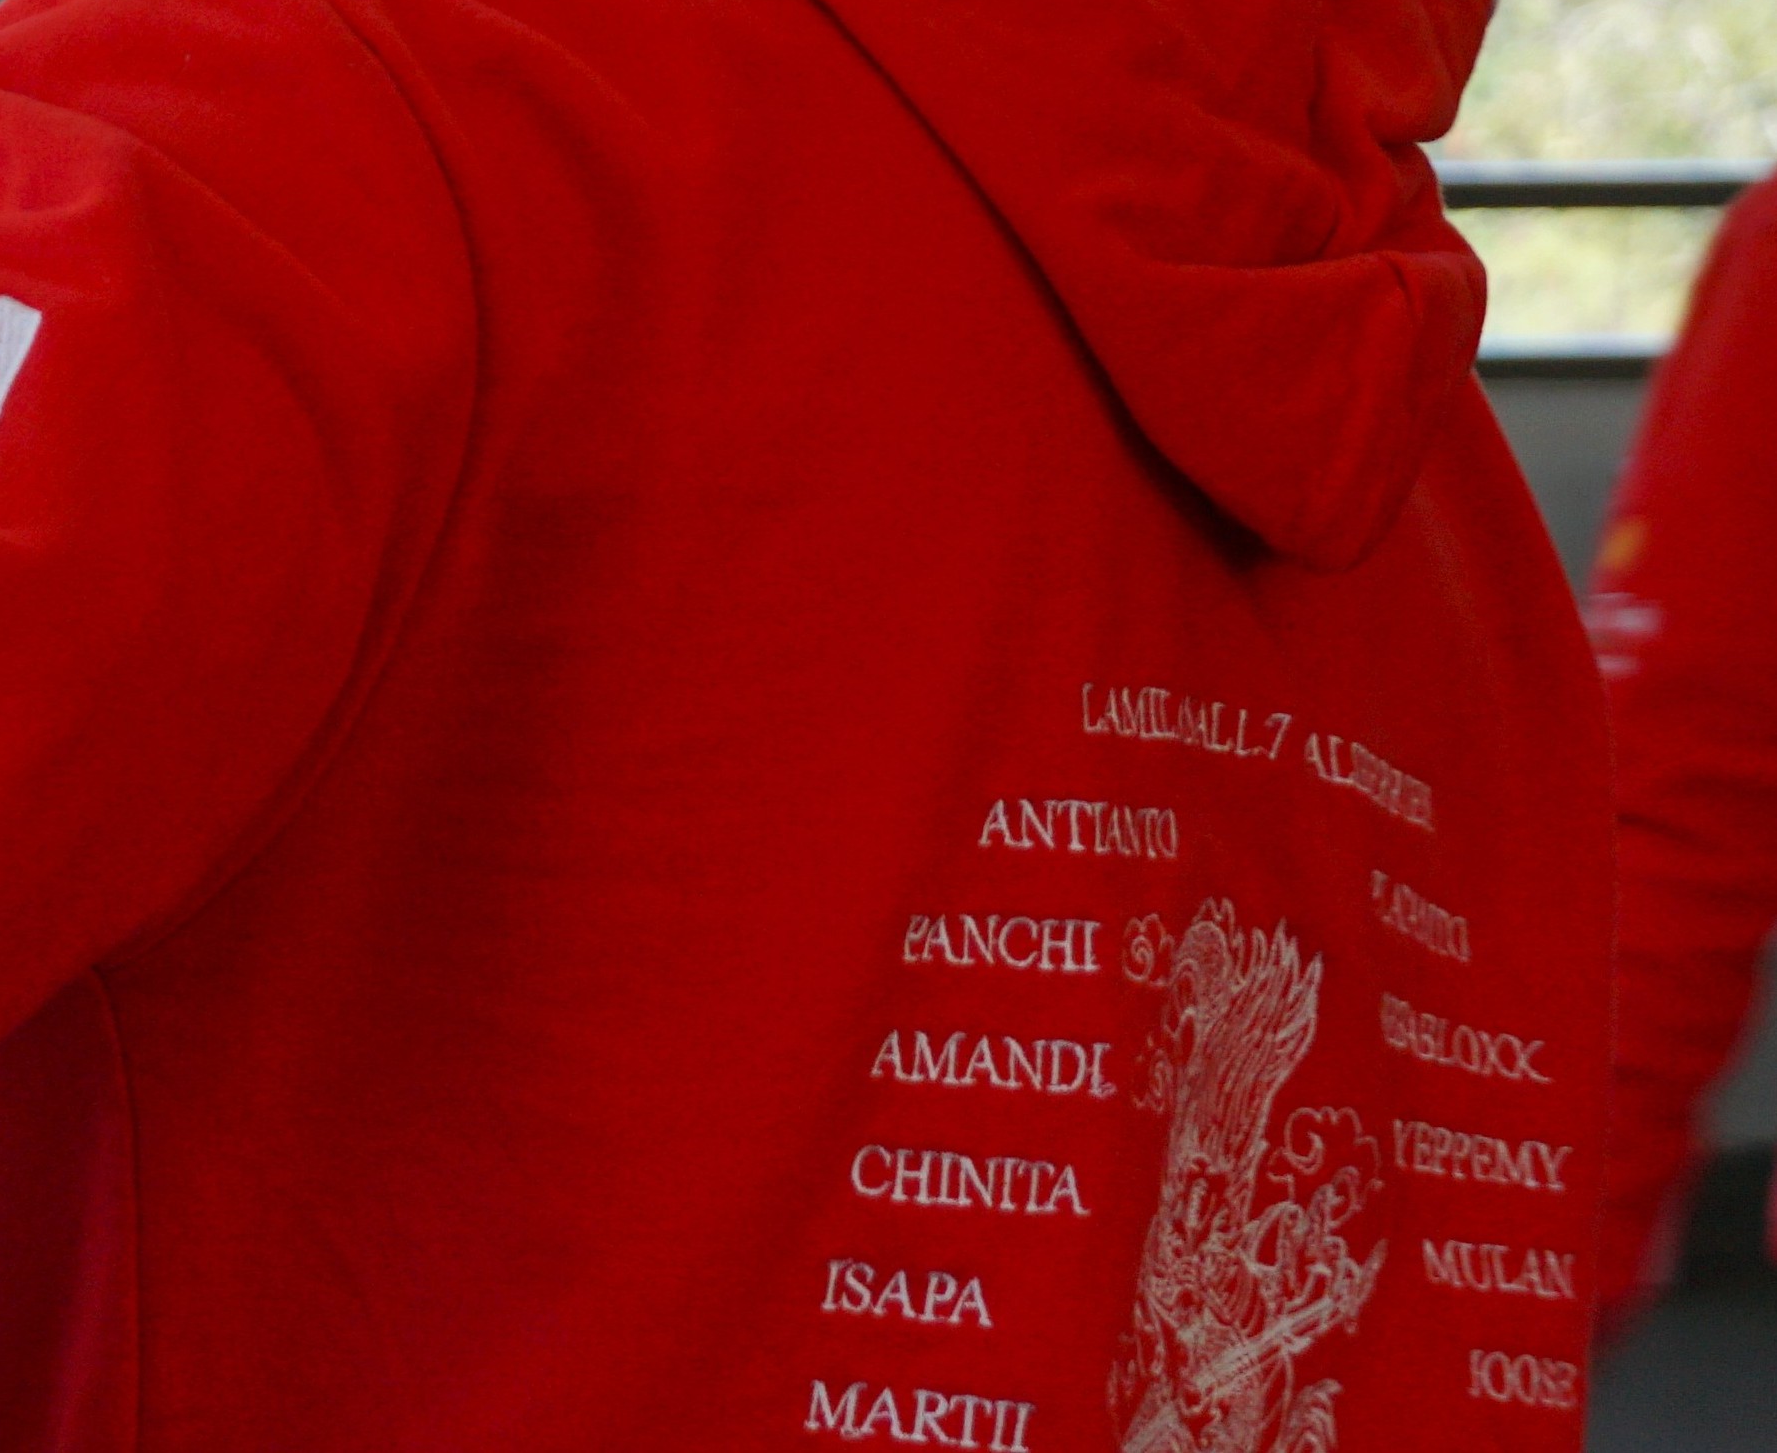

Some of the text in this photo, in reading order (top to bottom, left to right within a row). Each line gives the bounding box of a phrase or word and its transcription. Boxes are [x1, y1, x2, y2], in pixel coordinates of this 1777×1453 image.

[851, 1146, 1089, 1215] CHINITA
[822, 1261, 992, 1328] ISAPA
[1423, 1239, 1574, 1299] MULAN
